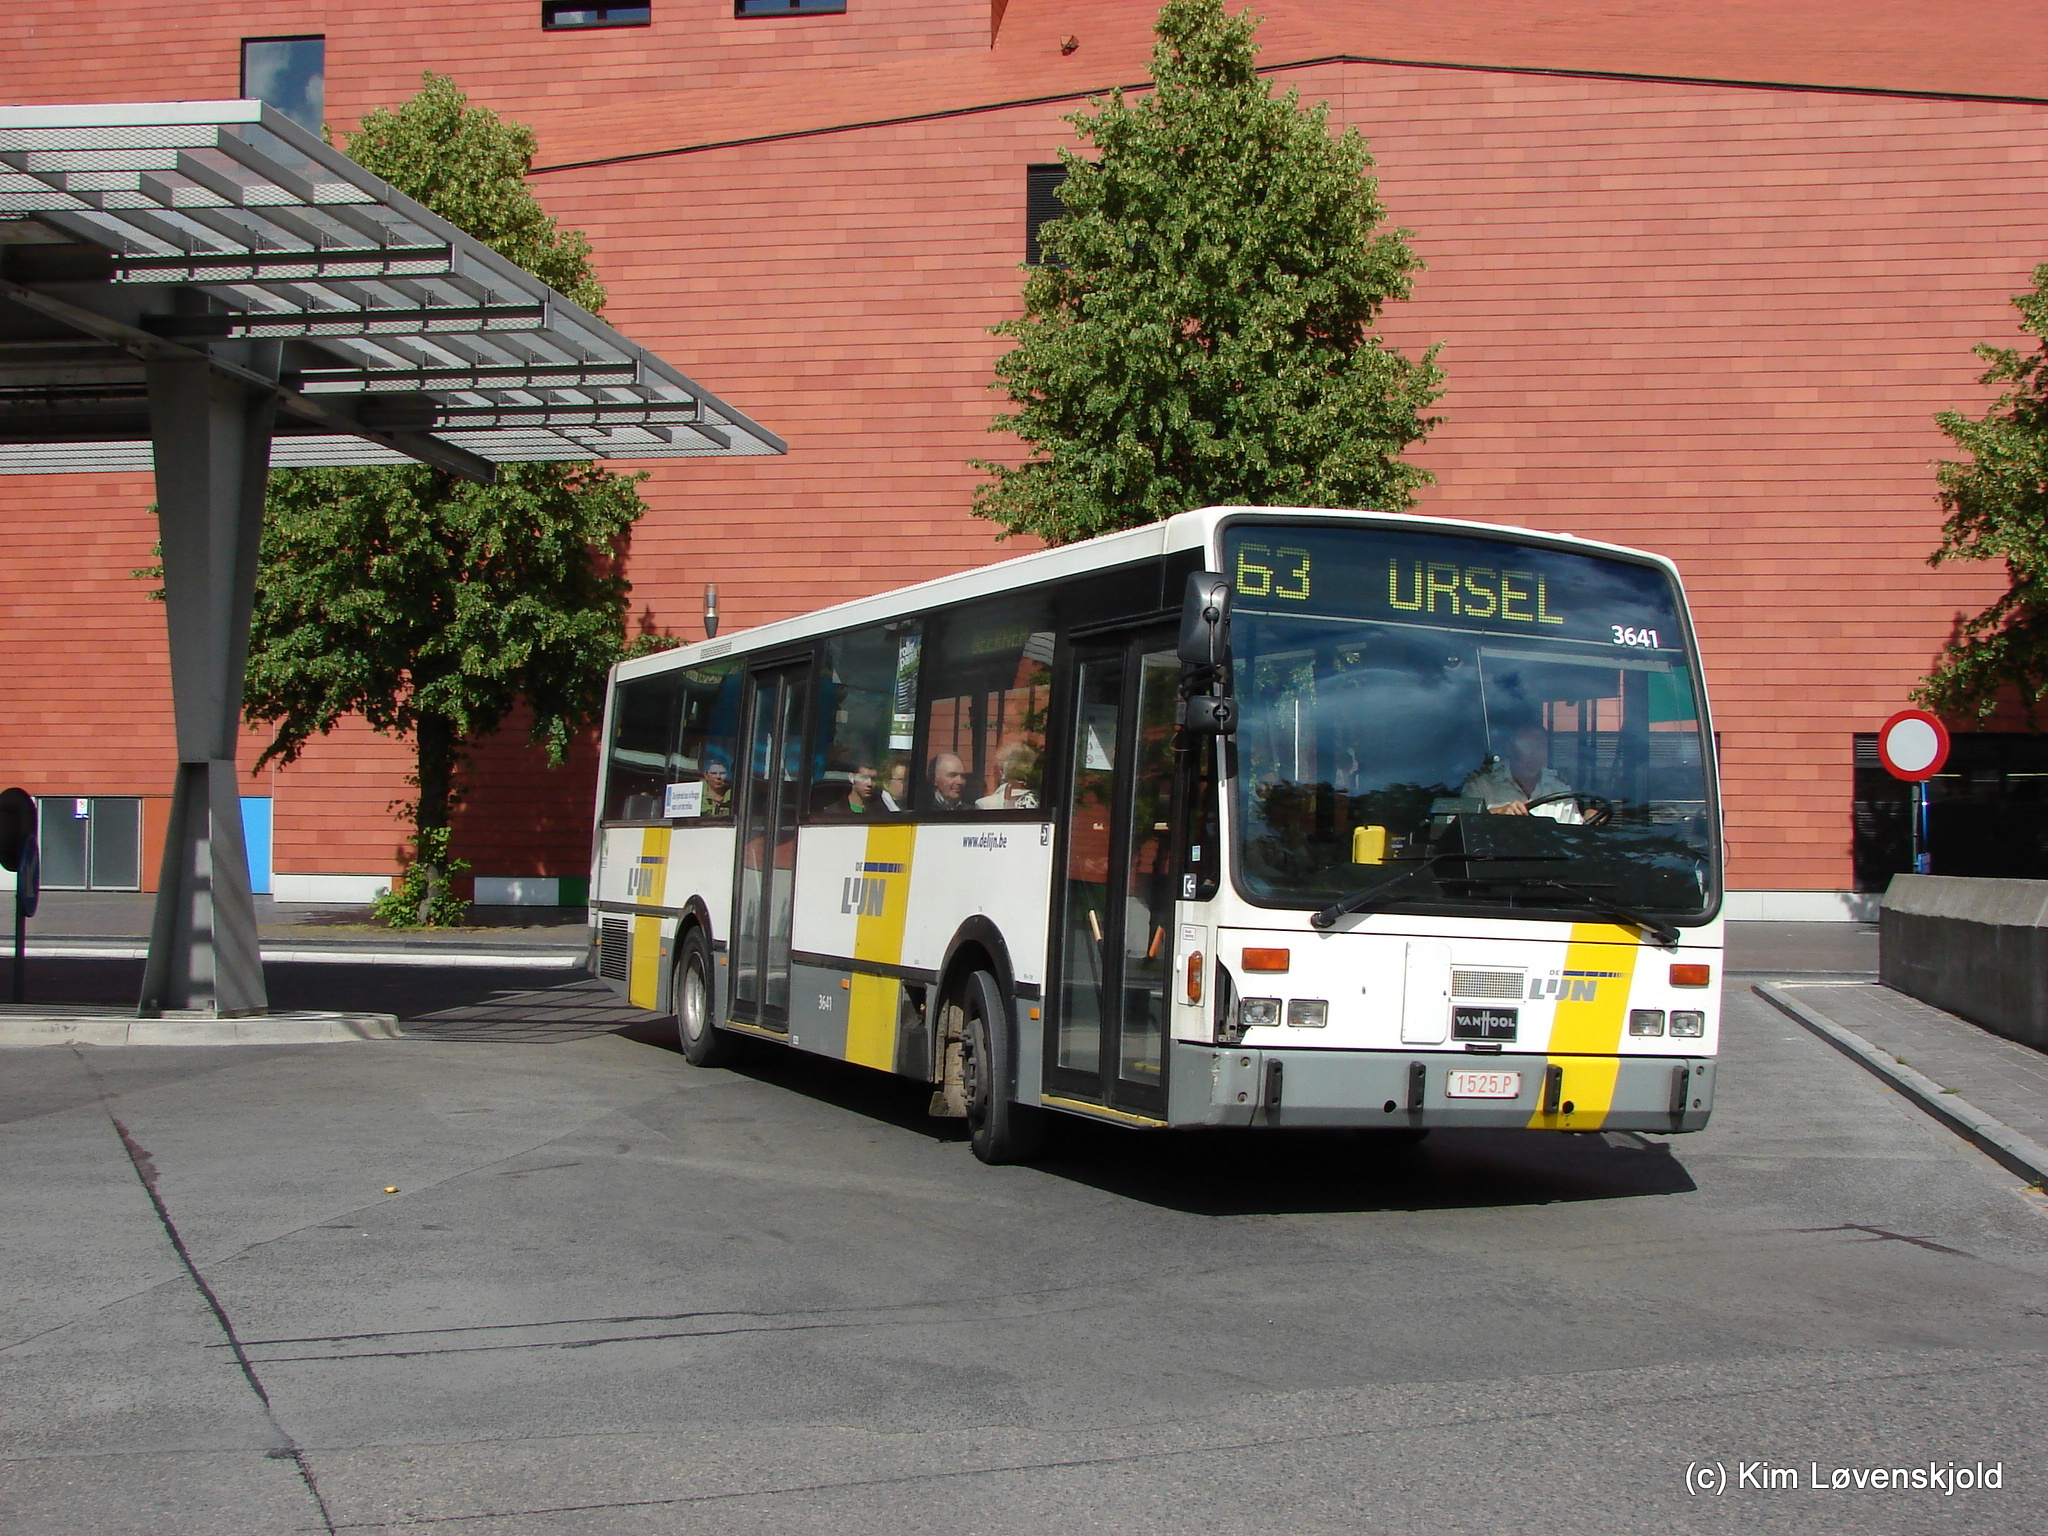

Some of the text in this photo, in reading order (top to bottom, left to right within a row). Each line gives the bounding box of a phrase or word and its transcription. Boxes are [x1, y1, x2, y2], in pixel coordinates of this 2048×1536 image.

[1236, 541, 1564, 626] 63 URSEL
[1611, 625, 1660, 650] 3641
[962, 832, 1008, 851] www.delijn.be
[855, 862, 863, 871] DE
[627, 868, 654, 897] LIJN
[841, 877, 887, 917] LIJN
[1528, 978, 1598, 1002] LIJN
[818, 994, 832, 1011] 3641
